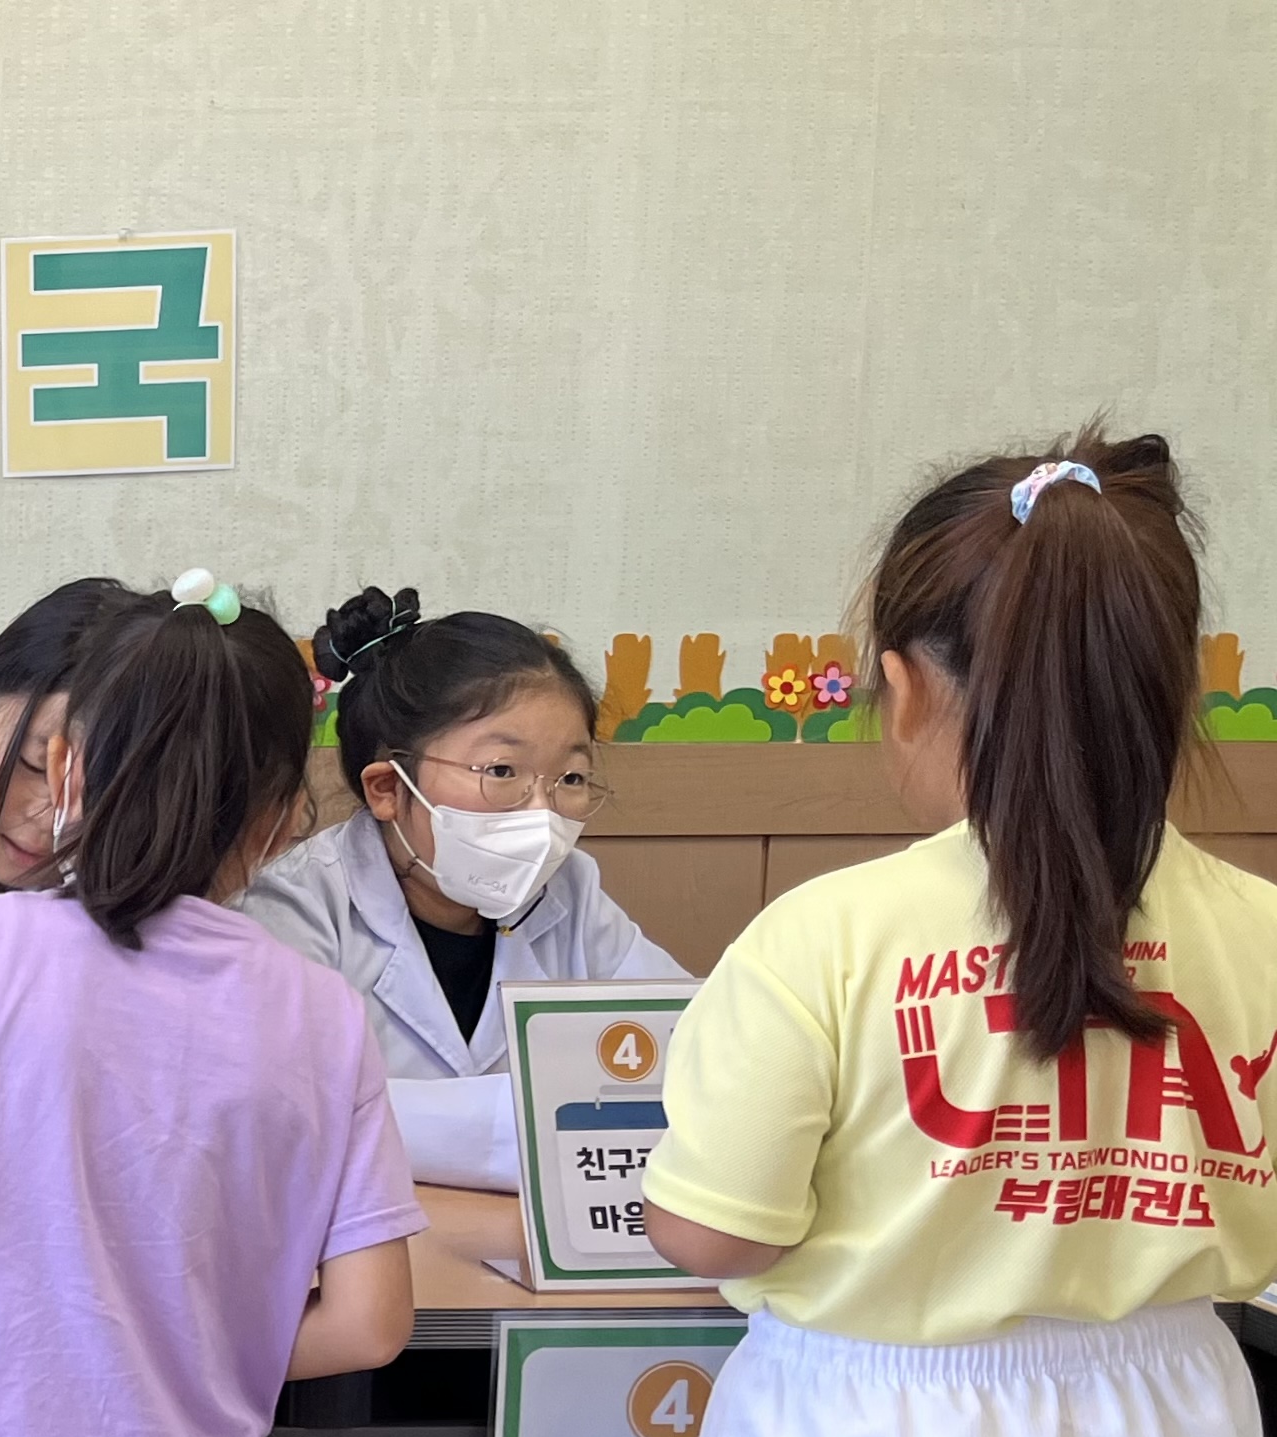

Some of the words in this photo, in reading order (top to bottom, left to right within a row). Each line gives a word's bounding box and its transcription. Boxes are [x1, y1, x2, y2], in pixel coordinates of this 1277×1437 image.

[612, 1032, 643, 1071] 4
[930, 1150, 1040, 1179] LEADER'S
[649, 1379, 694, 1434] 4
